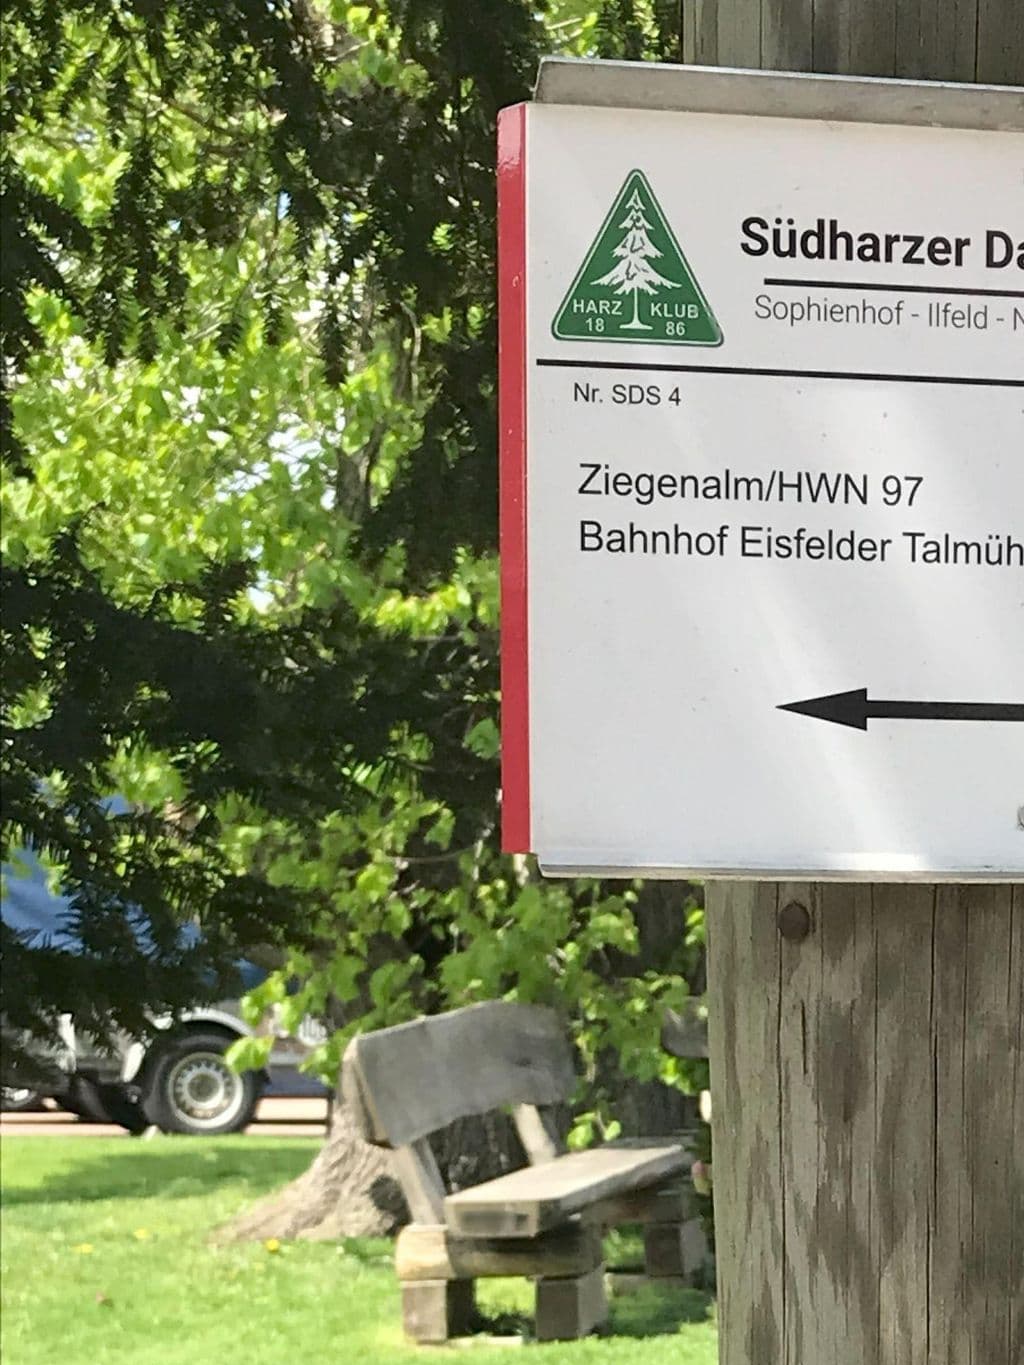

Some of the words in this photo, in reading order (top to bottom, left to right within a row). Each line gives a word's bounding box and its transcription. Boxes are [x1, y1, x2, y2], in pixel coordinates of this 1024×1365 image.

[740, 216, 971, 267] Südharzer
[573, 298, 623, 316] HARZ
[650, 302, 699, 319] KLUB
[585, 317, 605, 333] 18
[665, 321, 686, 336] 86
[754, 294, 905, 327] Sophienhof
[928, 302, 988, 330] Ilfeld
[574, 382, 603, 403] Nr.
[611, 383, 661, 406] SDS
[668, 386, 682, 407] 4
[577, 462, 868, 506] Ziegenalm/HWN
[882, 474, 924, 507] 97
[580, 520, 730, 557] Bahnhof
[741, 525, 893, 562] Eisfelder
